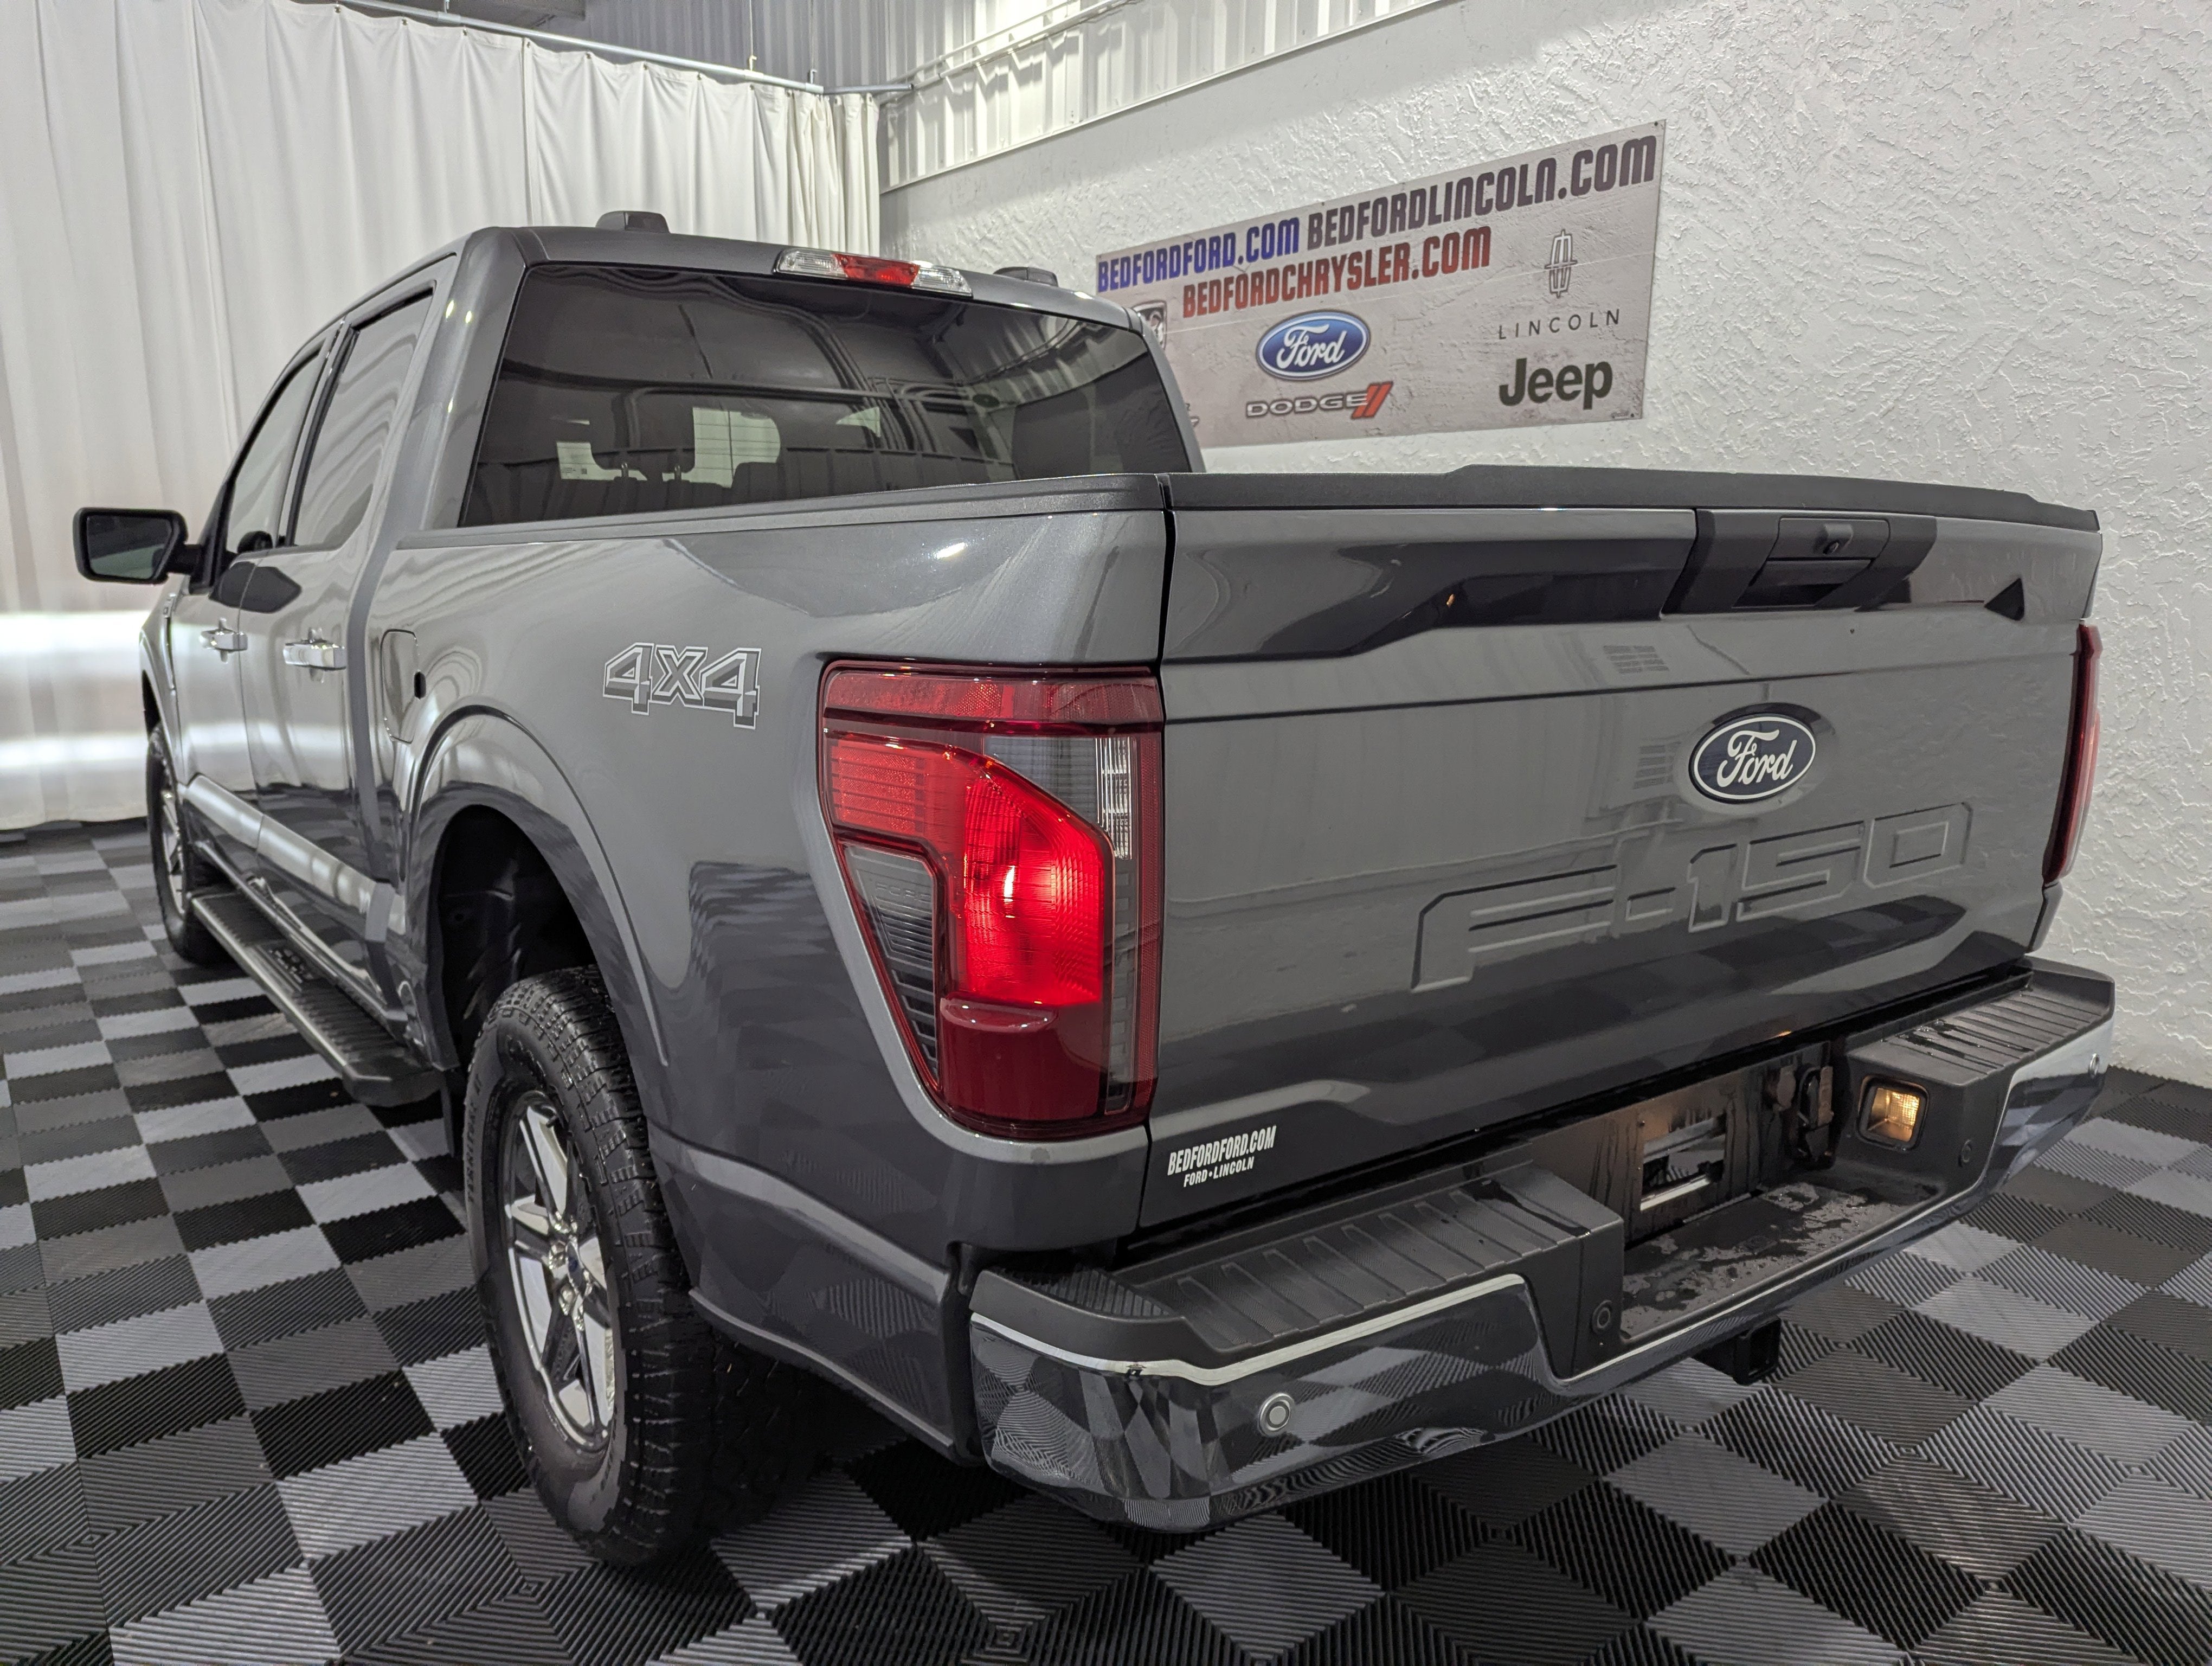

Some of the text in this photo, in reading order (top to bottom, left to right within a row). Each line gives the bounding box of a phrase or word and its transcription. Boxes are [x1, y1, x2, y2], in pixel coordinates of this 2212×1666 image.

[1098, 135, 1657, 293] BEDFORDFORD.COM BEDFORDLINCOLN.COM
[1183, 226, 1491, 318] BEDFORDCHRYSLER.COM
[1276, 324, 1347, 369] Ford
[1499, 309, 1619, 340] LINCOLN
[1246, 389, 1369, 419] DODGE
[1499, 357, 1613, 410] Jeep
[1716, 729, 1797, 786] Ford
[1411, 801, 1972, 992] F-150
[1167, 1125, 1277, 1176] BEDFORDFORD.COM
